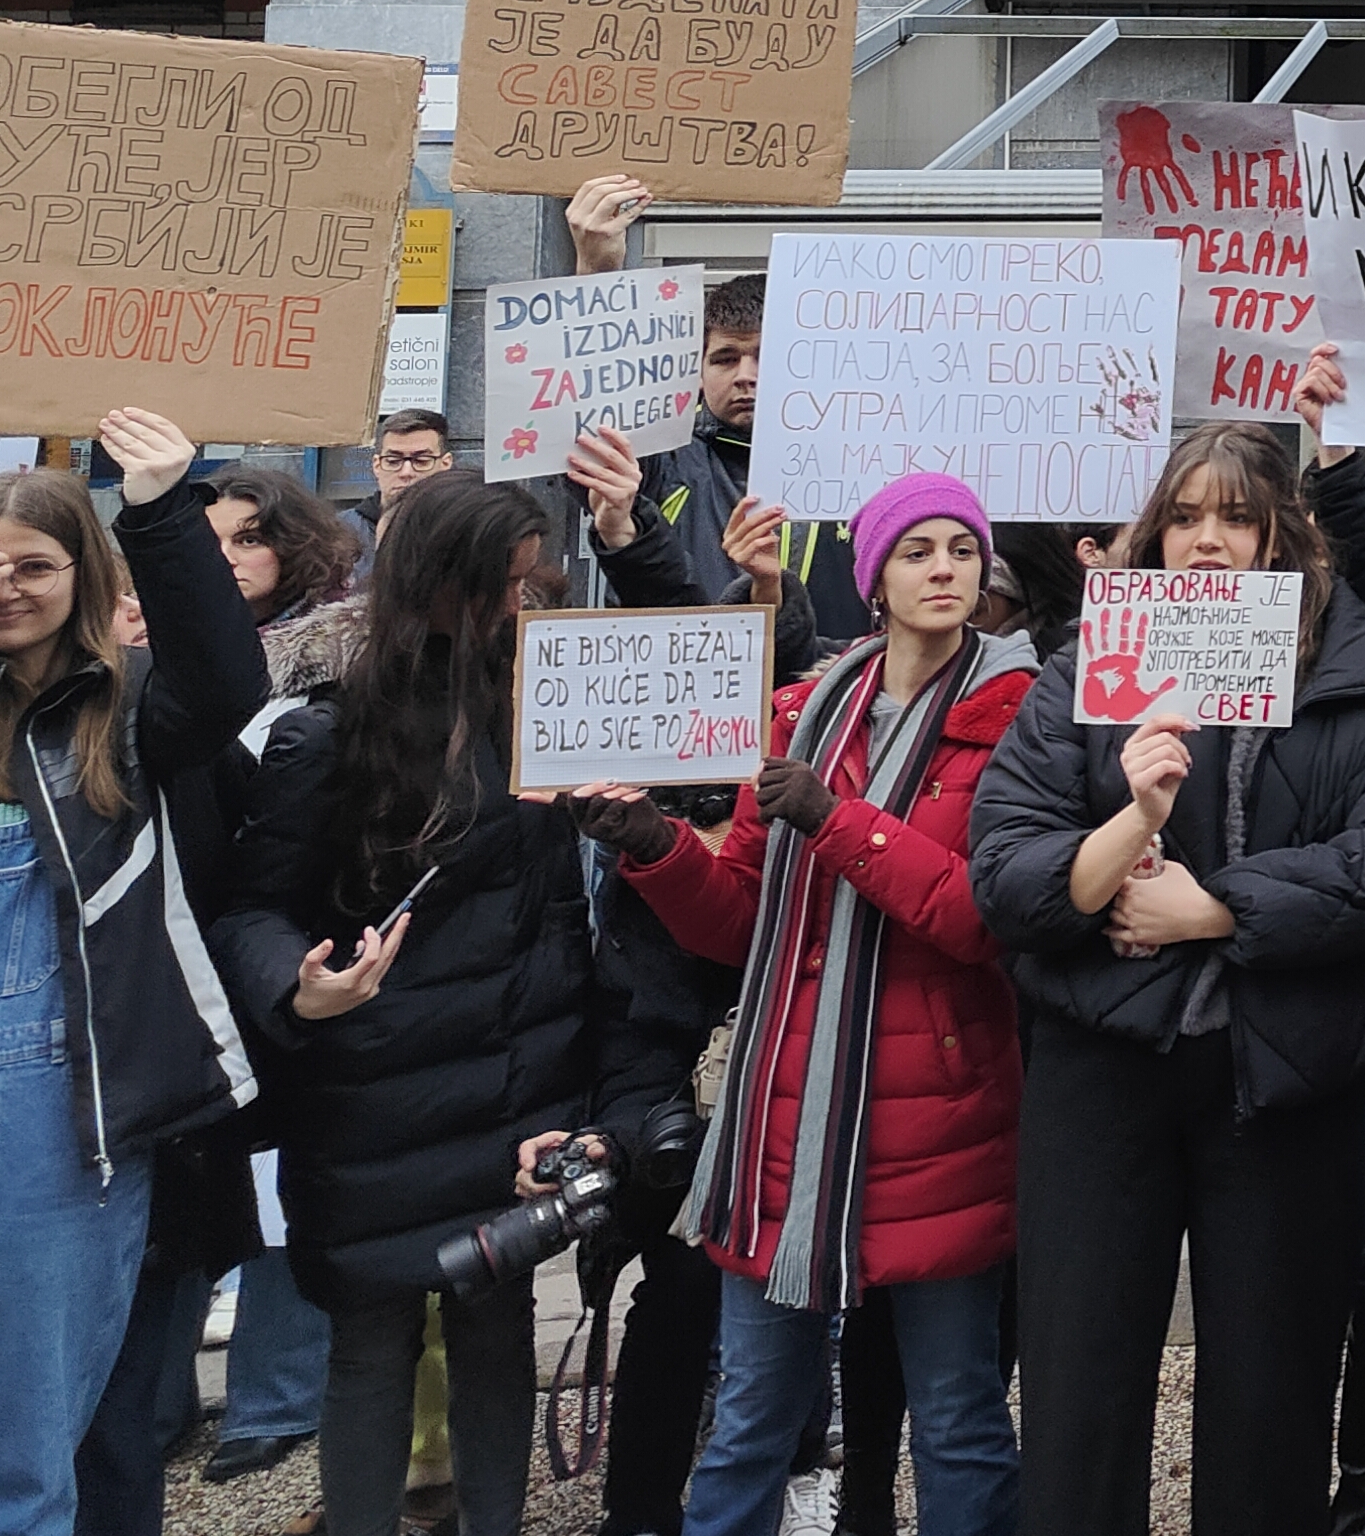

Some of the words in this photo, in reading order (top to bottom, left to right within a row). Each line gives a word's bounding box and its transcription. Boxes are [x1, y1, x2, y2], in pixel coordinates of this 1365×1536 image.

[577, 14, 660, 62] ДА
[687, 18, 836, 72] БУДУ
[0, 52, 247, 133] БЕГЛИ
[264, 76, 368, 147] ОД
[499, 64, 752, 113] САВЕСТ
[495, 110, 816, 168] ДРУШТВА!
[793, 240, 897, 281] ИАКО
[907, 241, 974, 283] СМО
[796, 289, 1078, 334] СОЛИДАРНОСТ
[1084, 292, 1155, 333] НАС
[389, 356, 438, 371] salon
[679, 350, 699, 378] UZ
[927, 341, 970, 382] ЗА
[574, 394, 674, 445] KOLEGE
[781, 390, 909, 432] СУТРА
[781, 443, 822, 477] ЗА
[1088, 571, 1246, 605] ОБРАЗОВАЊЕ
[537, 637, 568, 667] NE
[577, 633, 652, 666] BISMO
[668, 620, 753, 665] BEŽALI
[1146, 649, 1253, 672] УПОТРЕБИТИ
[1259, 649, 1288, 672] ДА
[534, 677, 569, 707] OD
[663, 670, 697, 704] DA
[712, 670, 741, 699] JE
[1183, 672, 1275, 693] ПРОМЕНИТЕ
[1198, 693, 1277, 723] СВЕТ
[532, 718, 589, 752] BILO
[599, 715, 643, 751] SVE
[651, 714, 683, 750] PO
[585, 1385, 600, 1435] Canon
